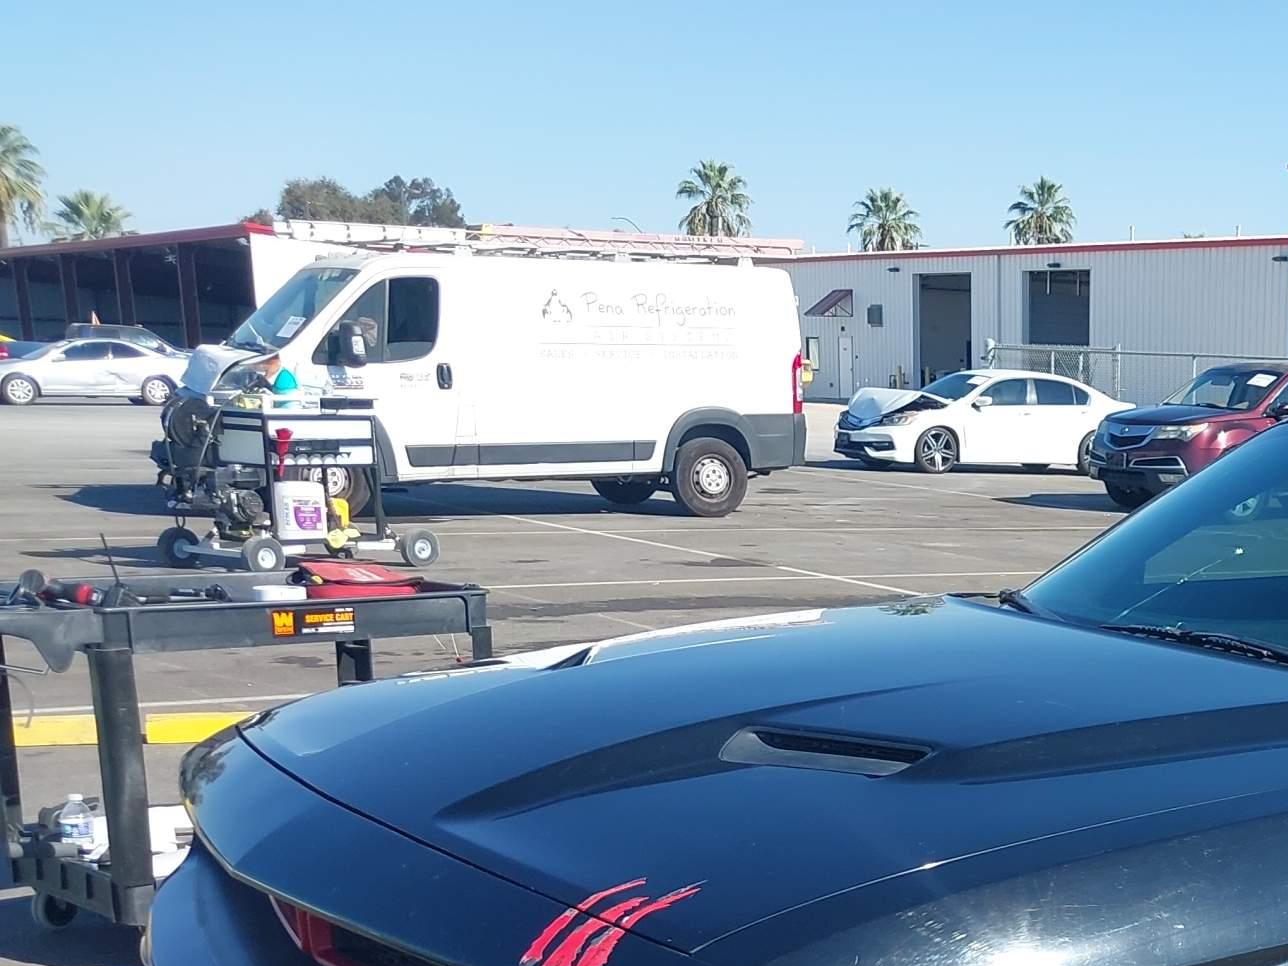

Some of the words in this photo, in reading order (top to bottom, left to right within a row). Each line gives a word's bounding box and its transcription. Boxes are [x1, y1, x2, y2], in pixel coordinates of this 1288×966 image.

[579, 291, 625, 316] Pena
[630, 292, 737, 328] Refrigeration
[305, 613, 335, 623] SERVICE
[335, 612, 354, 622] CART
